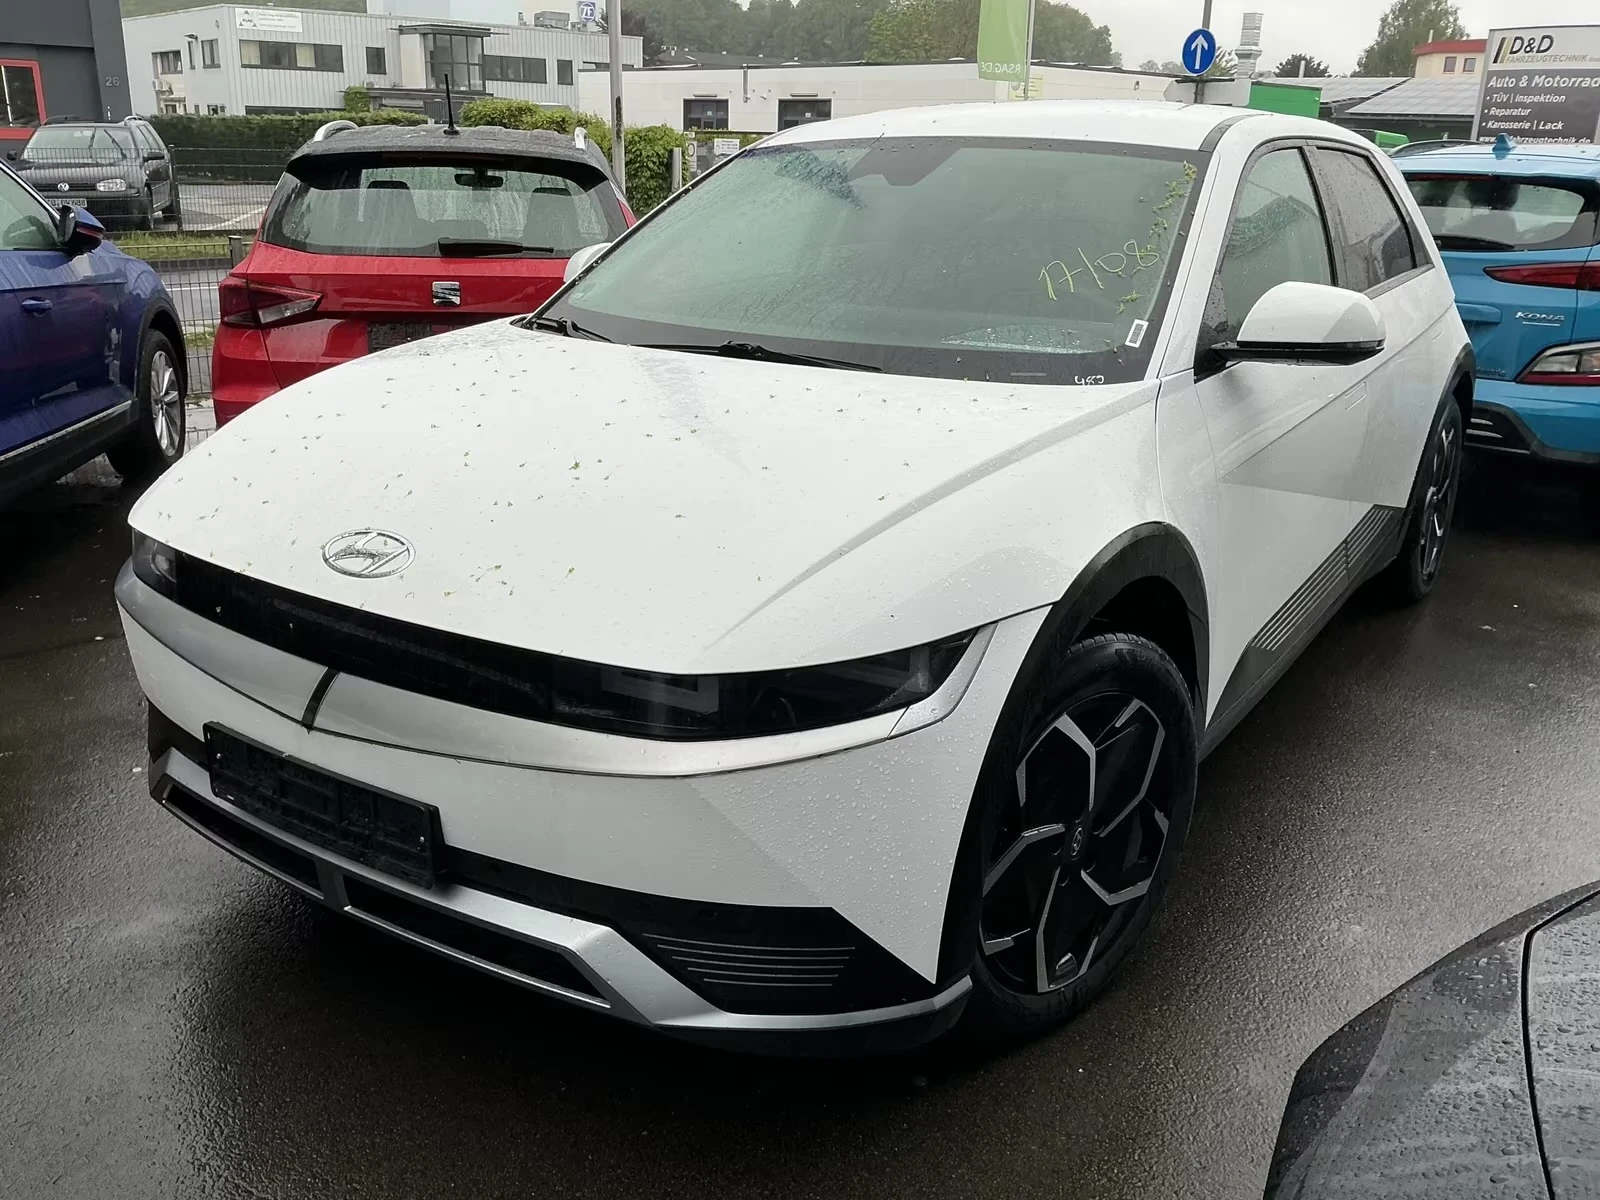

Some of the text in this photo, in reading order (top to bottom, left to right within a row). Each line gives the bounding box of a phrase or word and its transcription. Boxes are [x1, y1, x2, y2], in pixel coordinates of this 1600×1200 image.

[1509, 34, 1555, 55] D&D
[1506, 54, 1588, 63] FAHRZEUGTECHNIK
[105, 76, 120, 87] 26
[1487, 76, 1516, 88] Auto
[1518, 75, 1529, 88] &
[1492, 92, 1567, 104] TÜV Inspektion
[1489, 106, 1532, 117] Reparatur
[1486, 120, 1565, 131] Karosserie Lack
[1515, 311, 1565, 321] KONA
